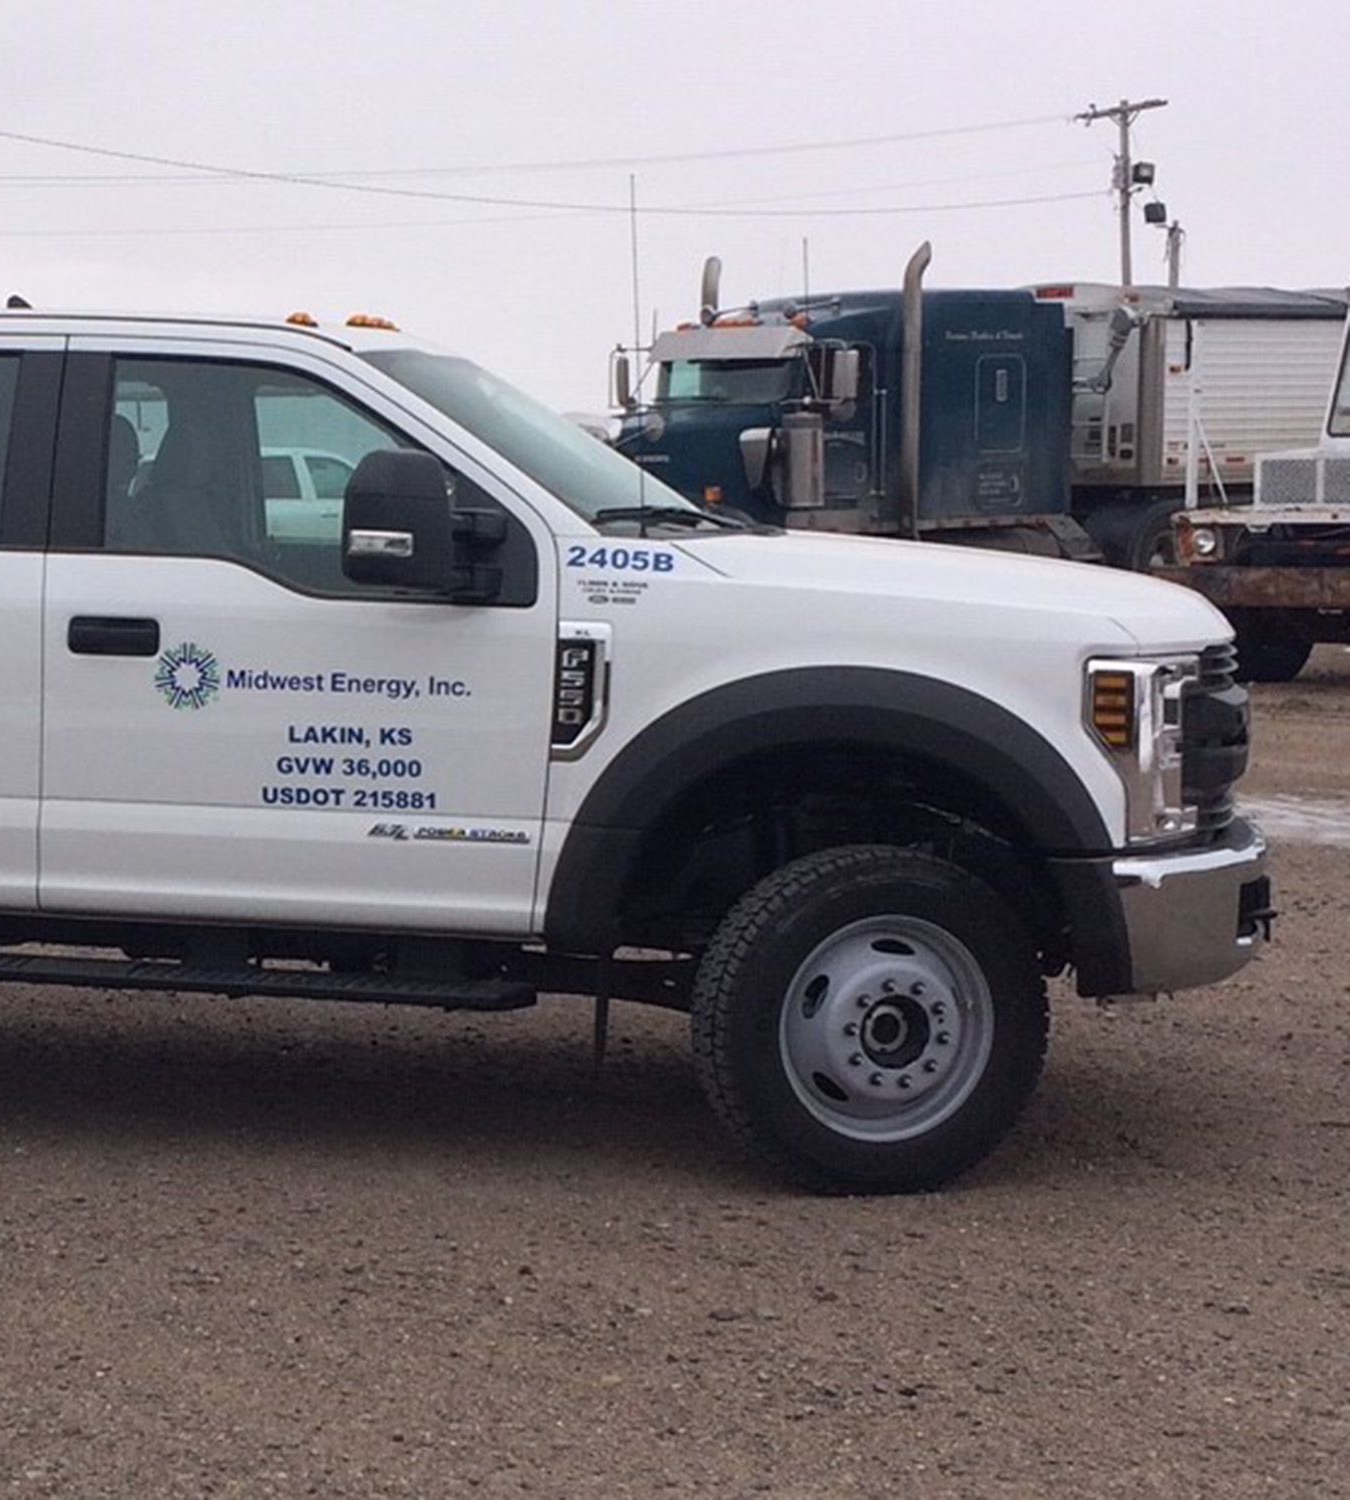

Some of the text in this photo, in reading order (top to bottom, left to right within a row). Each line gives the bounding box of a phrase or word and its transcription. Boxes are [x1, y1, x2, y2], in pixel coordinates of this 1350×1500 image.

[567, 545, 674, 572] 2405B
[226, 669, 471, 699] Midwest Energy, Inc.
[288, 725, 413, 748] LAKIN, KS
[276, 756, 422, 780] GVW 36,000
[262, 786, 436, 809] USDOT 215881
